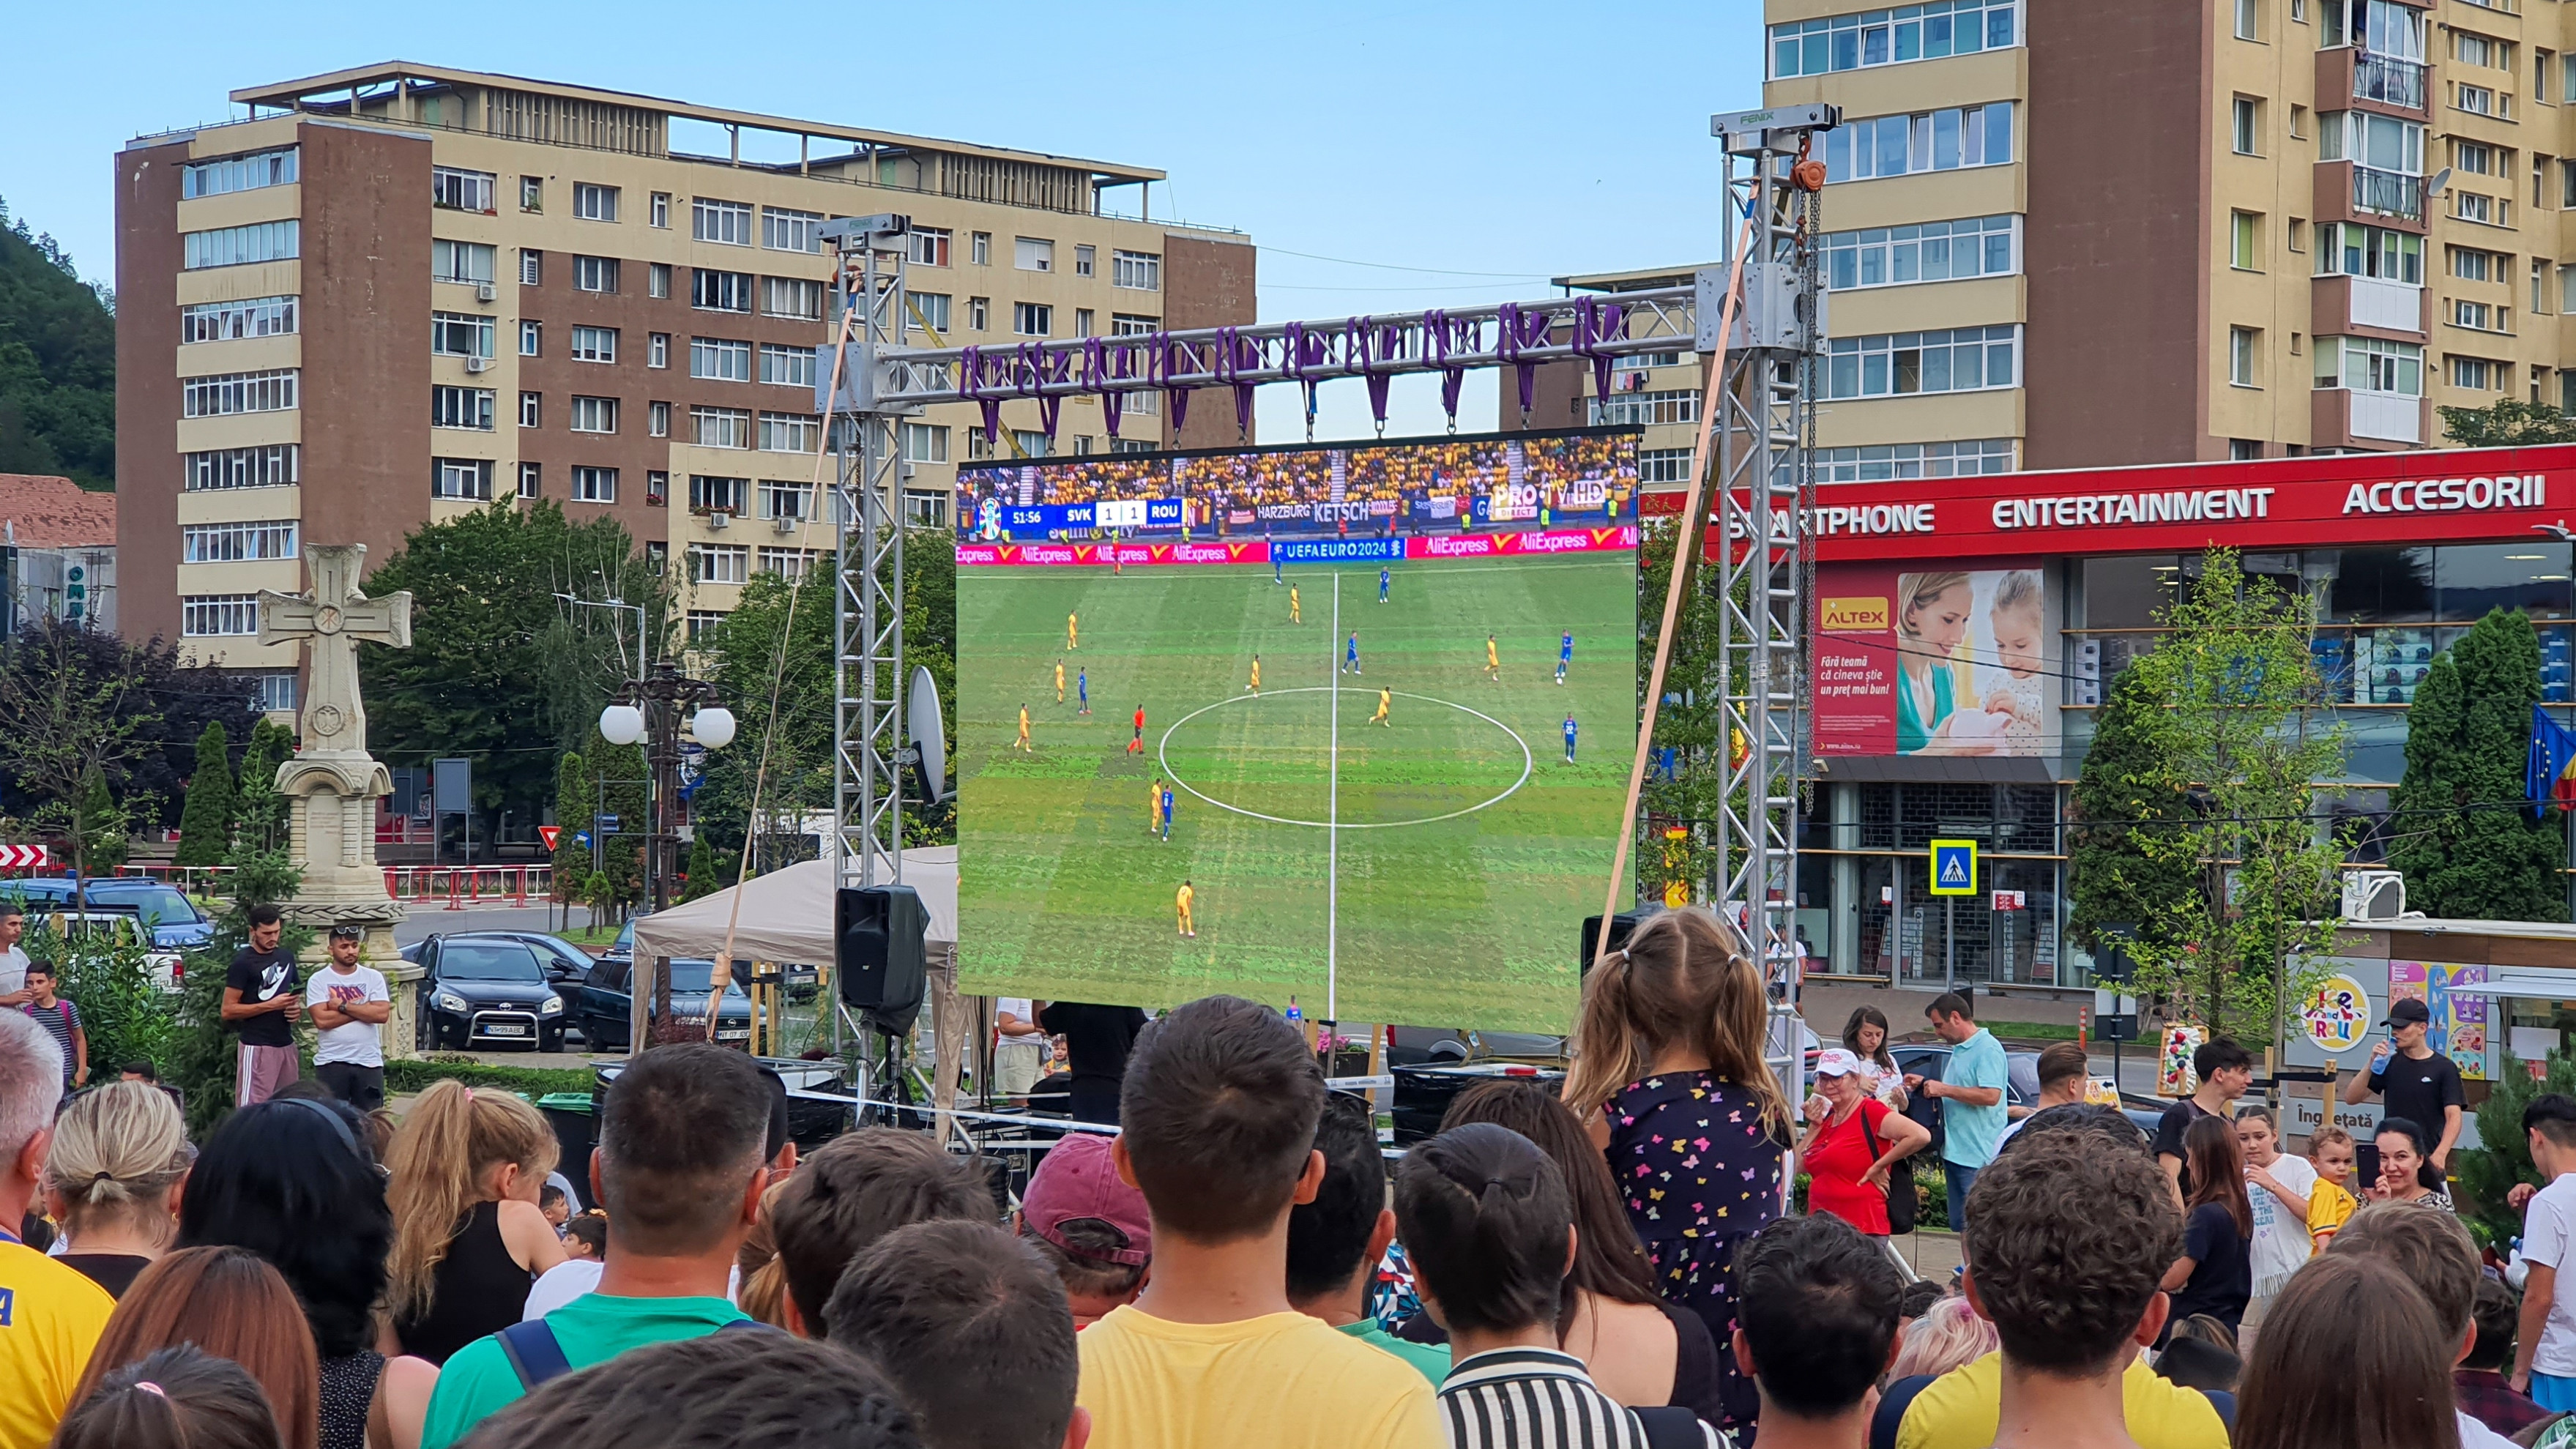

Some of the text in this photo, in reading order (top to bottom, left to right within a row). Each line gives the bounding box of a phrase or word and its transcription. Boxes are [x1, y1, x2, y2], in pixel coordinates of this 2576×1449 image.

[1741, 111, 1773, 124] FENIX
[1494, 484, 1537, 507] PRO
[1577, 483, 1603, 502] HD
[1992, 487, 2274, 529] ENTERTAINMENT
[2342, 475, 2545, 513] ACCESORII
[1013, 505, 1177, 524] 51:56 SVK 1 1 ROU
[1257, 504, 1311, 519] HARZBURG
[1314, 502, 1369, 523] KETSCH
[1502, 508, 1531, 517] DIRECT
[1021, 546, 1071, 564] AliExpress
[1172, 545, 1226, 563] AliExpress
[1425, 537, 1489, 555] AliExpress
[1519, 532, 1587, 551] AliExpress
[1821, 655, 1868, 667] Fără teamă
[1821, 669, 1831, 680] că
[1834, 669, 1864, 680] cineva
[1821, 683, 1889, 697] un preț mai bun!
[2321, 1011, 2339, 1020] and
[2297, 1103, 2373, 1128] Îngețată
